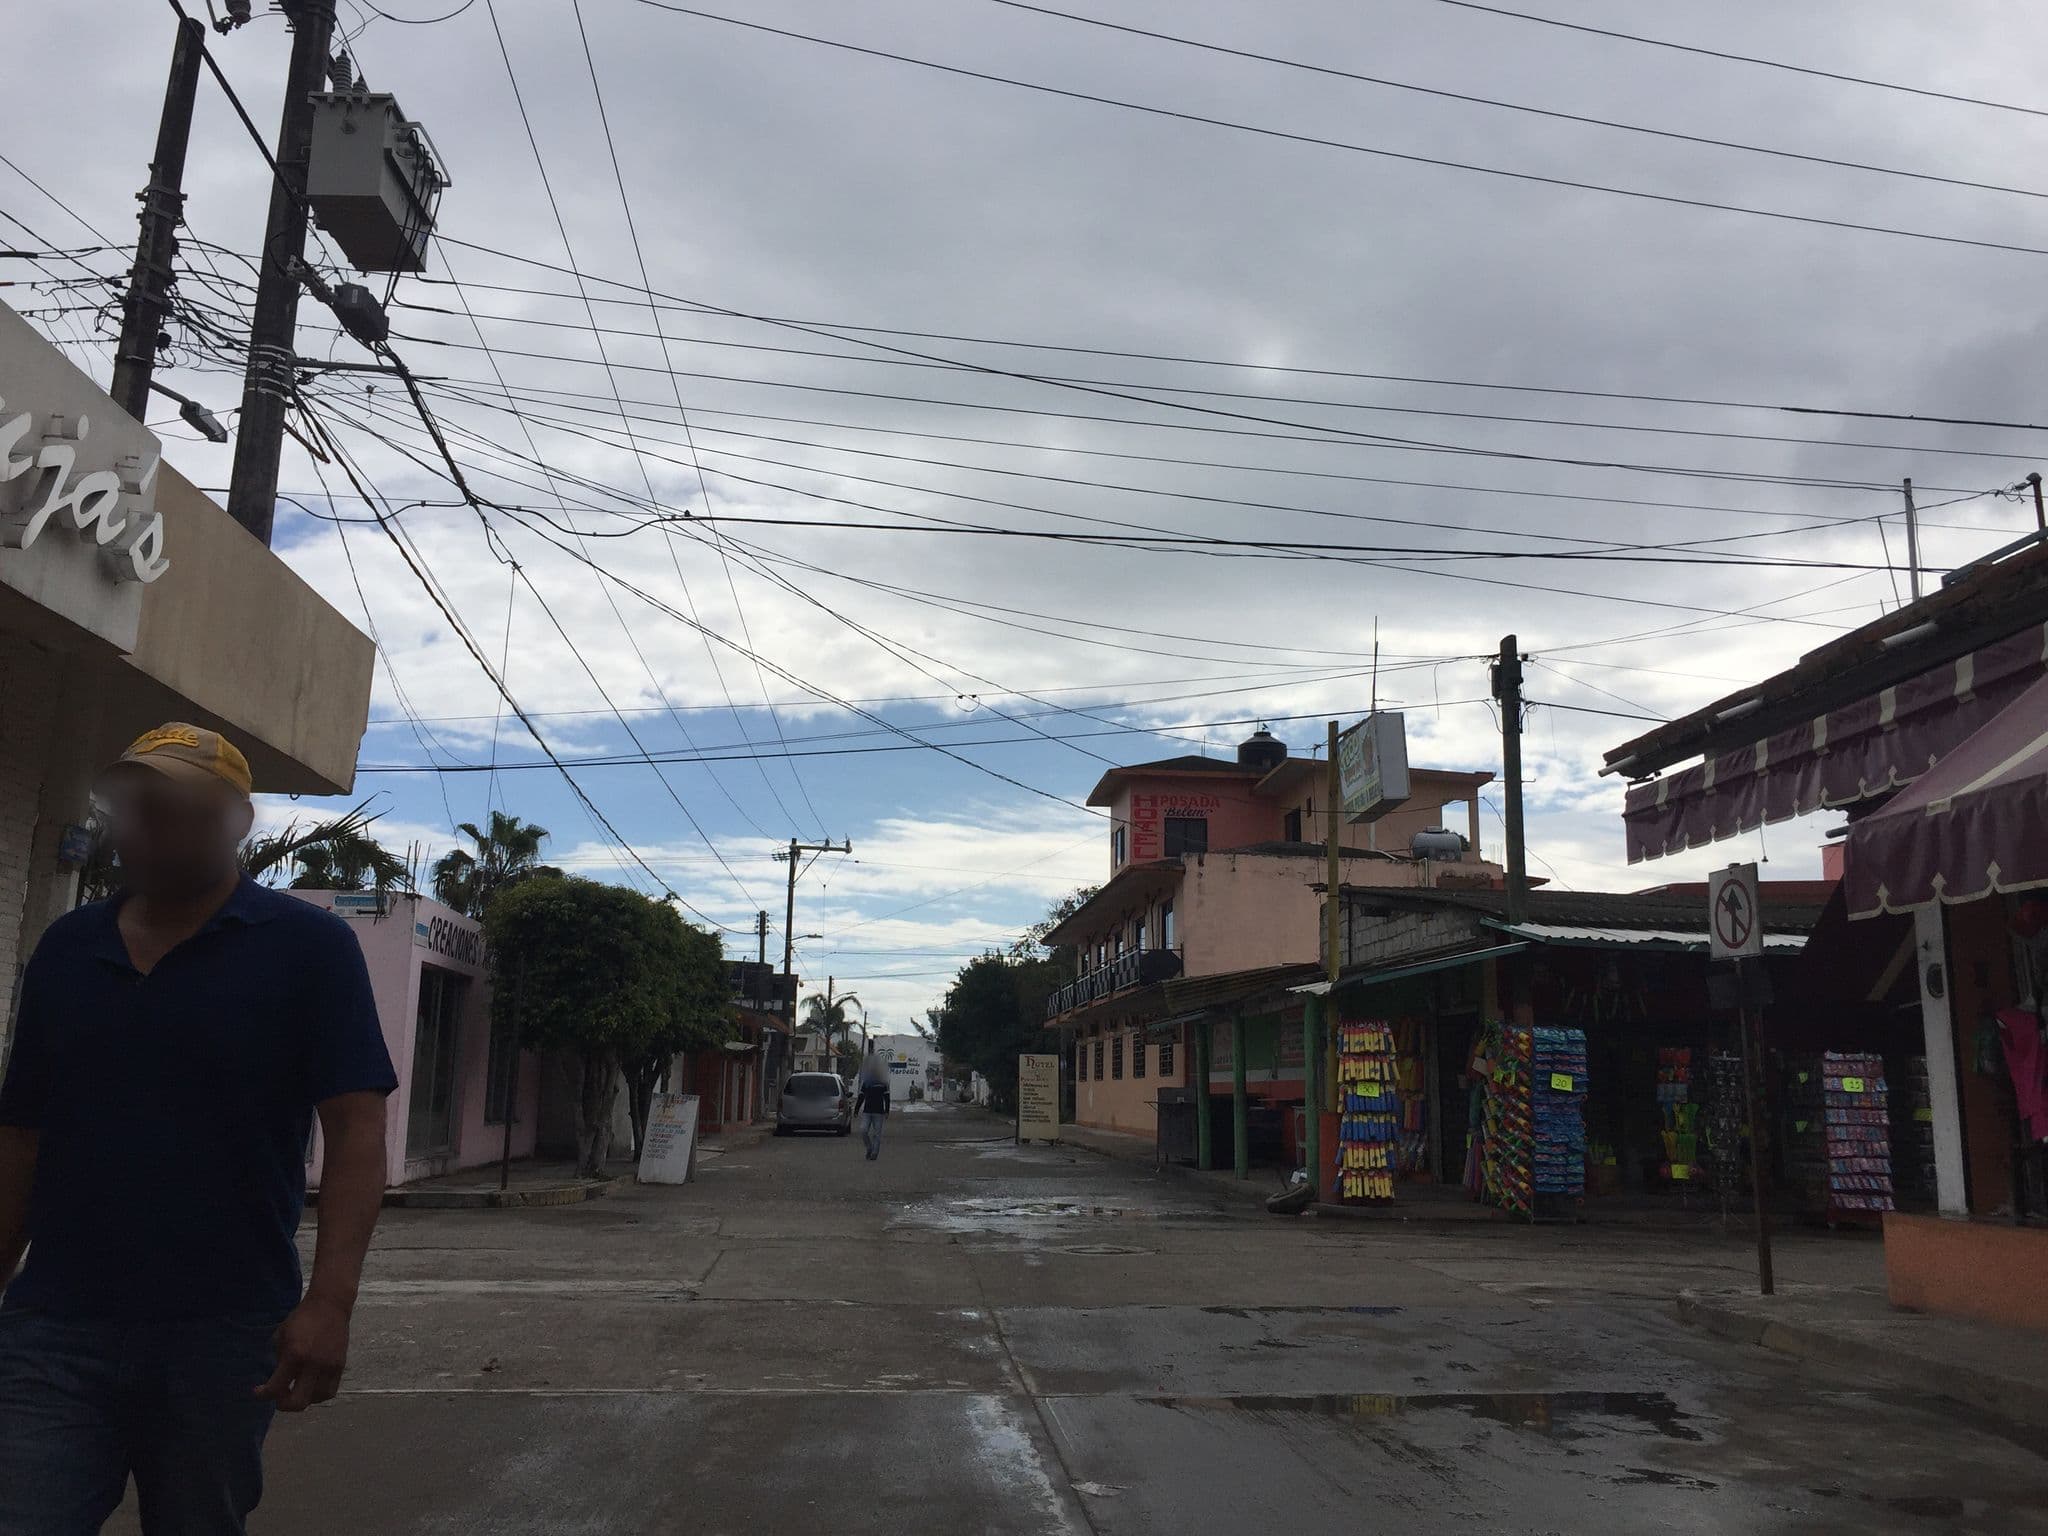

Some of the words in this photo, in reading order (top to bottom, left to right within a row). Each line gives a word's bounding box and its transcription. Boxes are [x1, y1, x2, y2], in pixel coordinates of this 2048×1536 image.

[1160, 795, 1221, 808] POSADA
[428, 916, 480, 966] CREACIONES
[1555, 1078, 1567, 1088] 20
